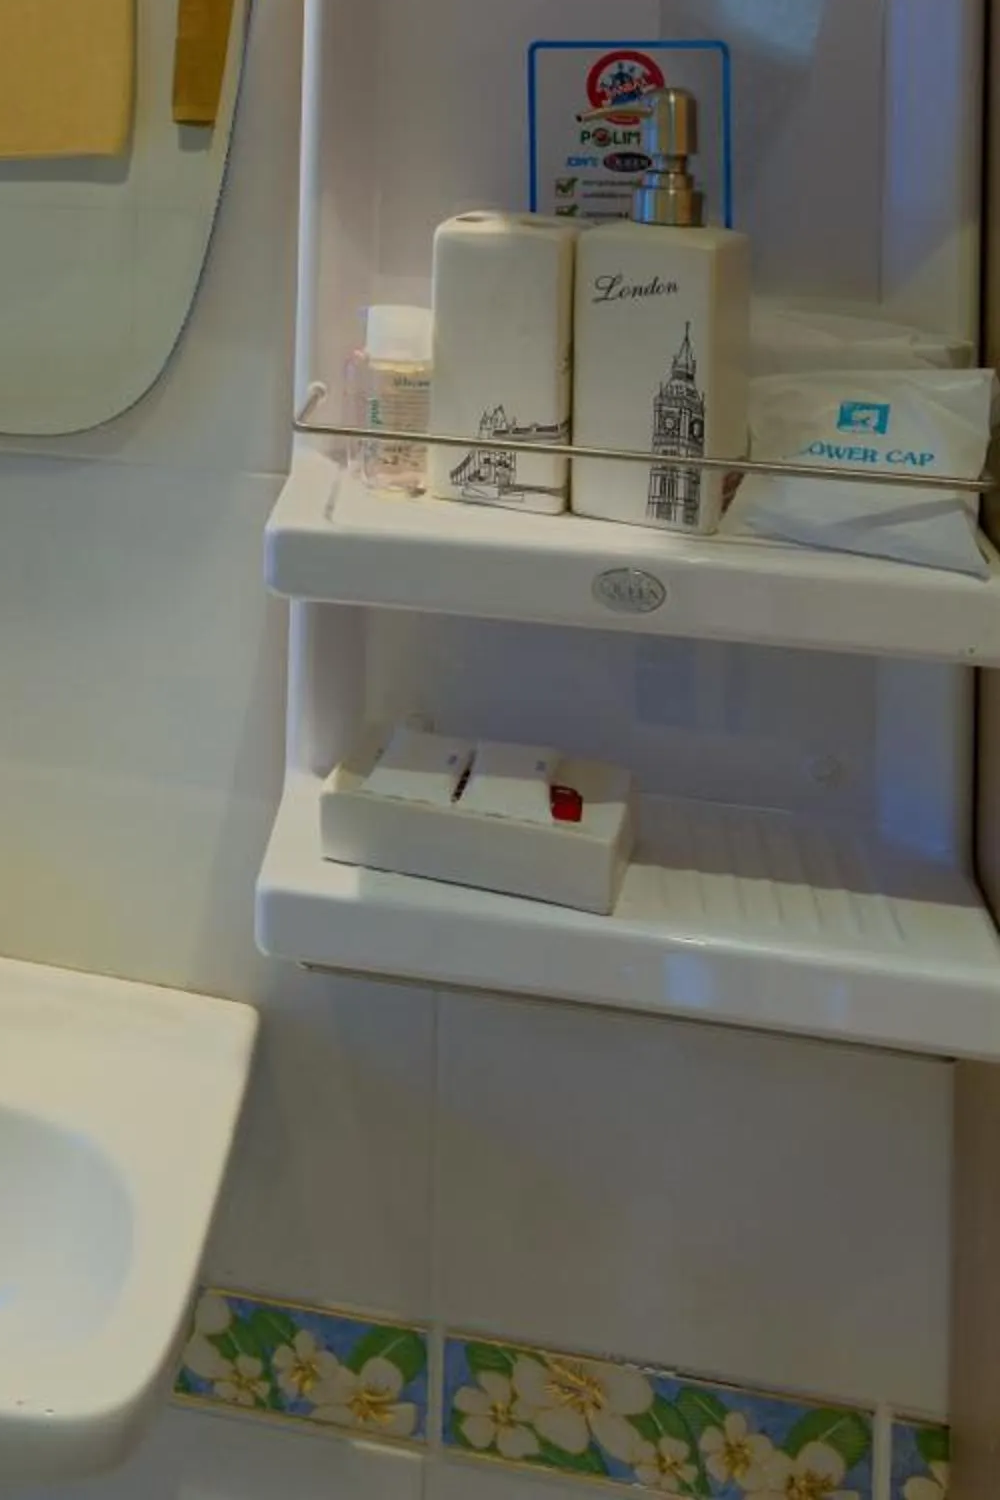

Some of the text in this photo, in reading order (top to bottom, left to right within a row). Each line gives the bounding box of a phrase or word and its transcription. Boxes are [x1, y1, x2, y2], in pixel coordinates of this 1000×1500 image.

[580, 128, 641, 147] POLIM
[591, 271, 679, 303] London
[809, 441, 935, 466] OWER CAP
